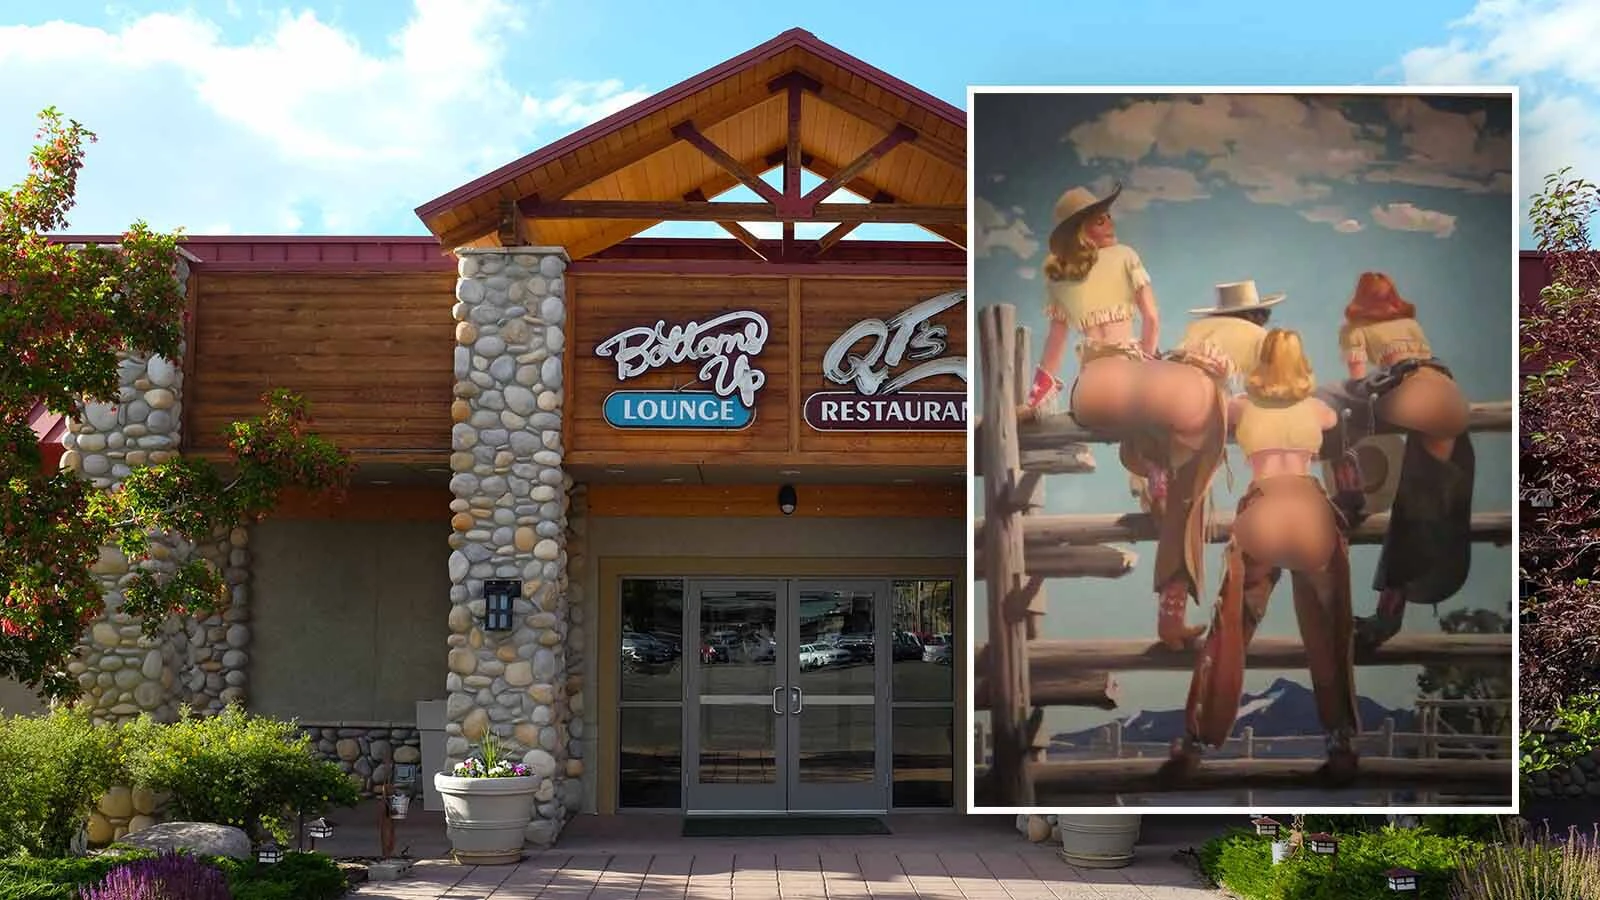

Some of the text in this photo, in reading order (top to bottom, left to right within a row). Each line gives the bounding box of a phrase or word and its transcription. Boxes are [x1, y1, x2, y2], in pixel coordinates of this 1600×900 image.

[595, 310, 768, 380] Bottoms
[699, 354, 766, 407] Up
[622, 399, 735, 421] LOUNGE
